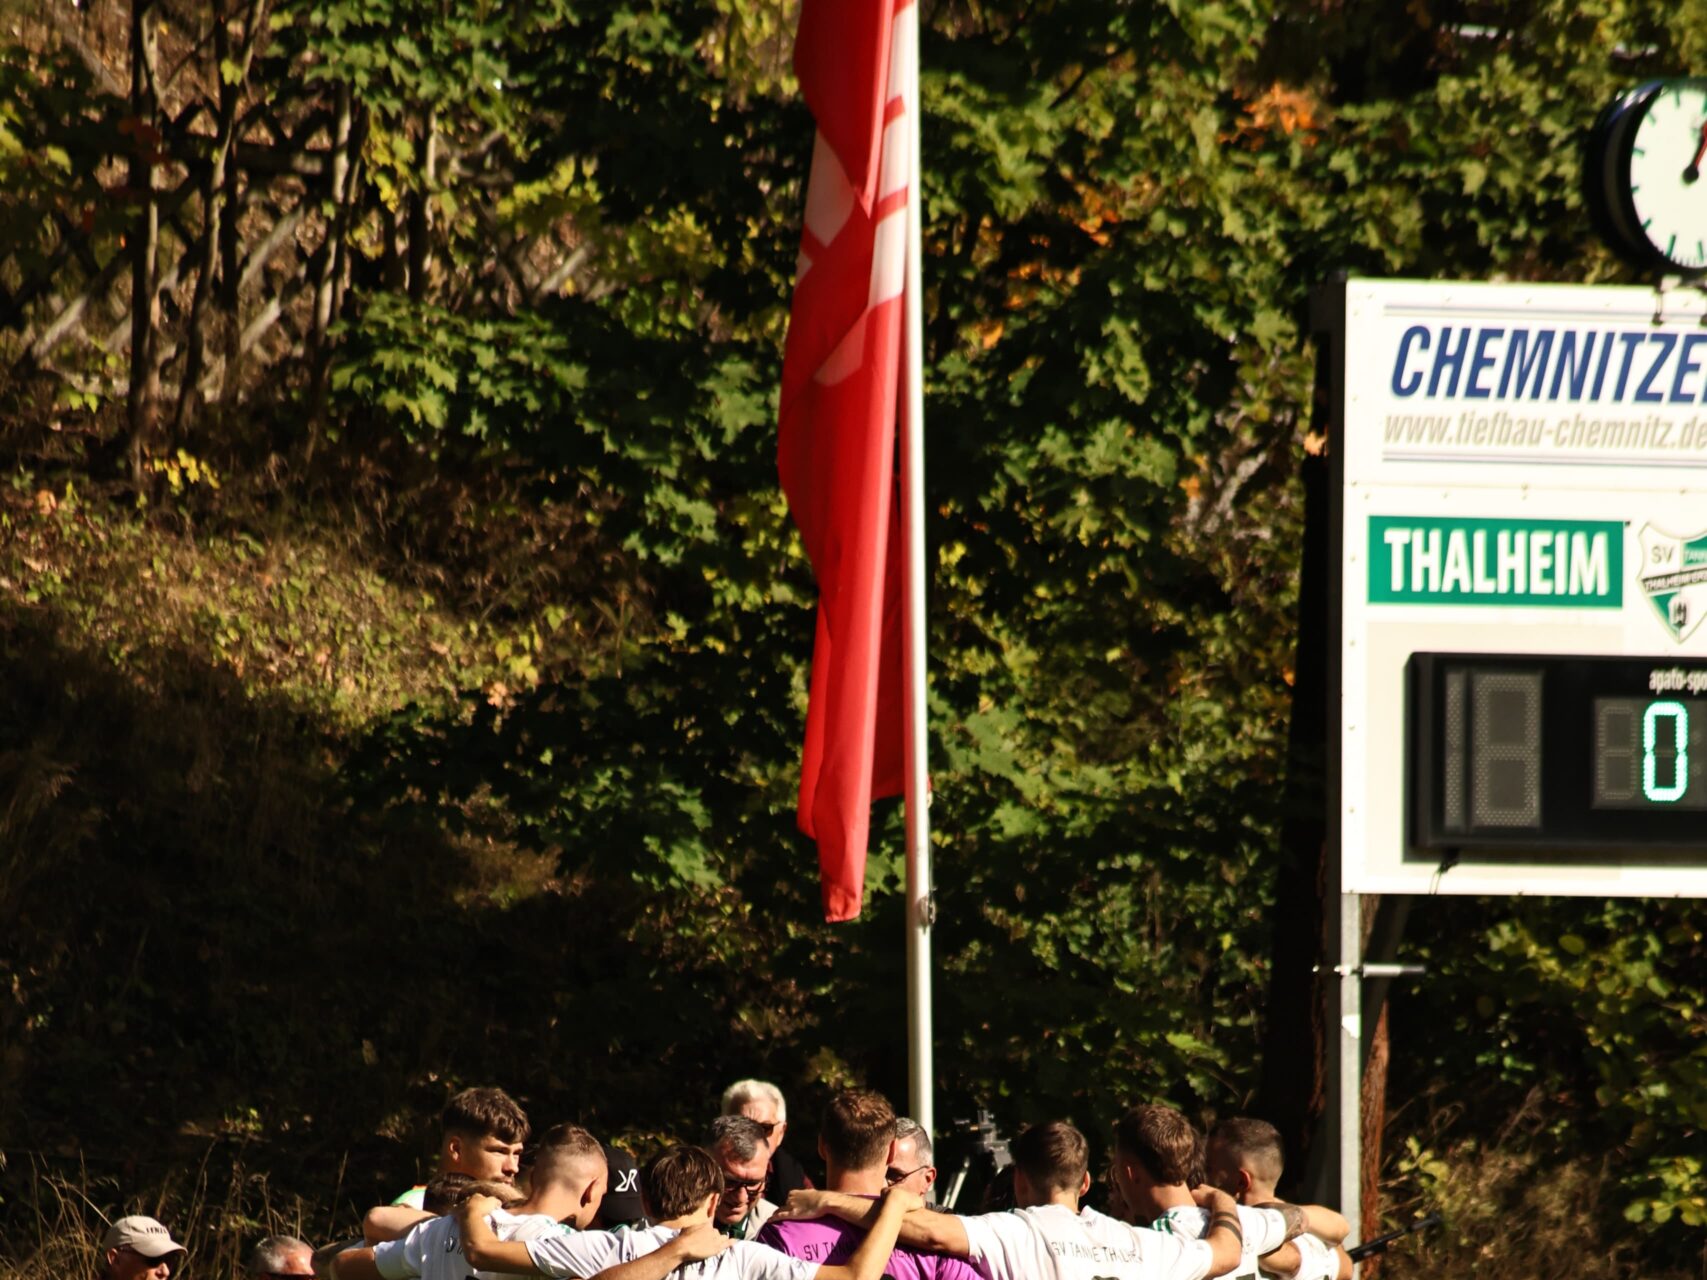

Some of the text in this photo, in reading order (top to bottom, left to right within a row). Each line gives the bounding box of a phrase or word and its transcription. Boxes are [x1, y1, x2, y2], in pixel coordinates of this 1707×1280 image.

[1390, 324, 1707, 404] CHEMNITZE
[1383, 528, 1610, 597] THALHEIM
[1651, 545, 1674, 564] SV
[1643, 701, 1688, 802] 0
